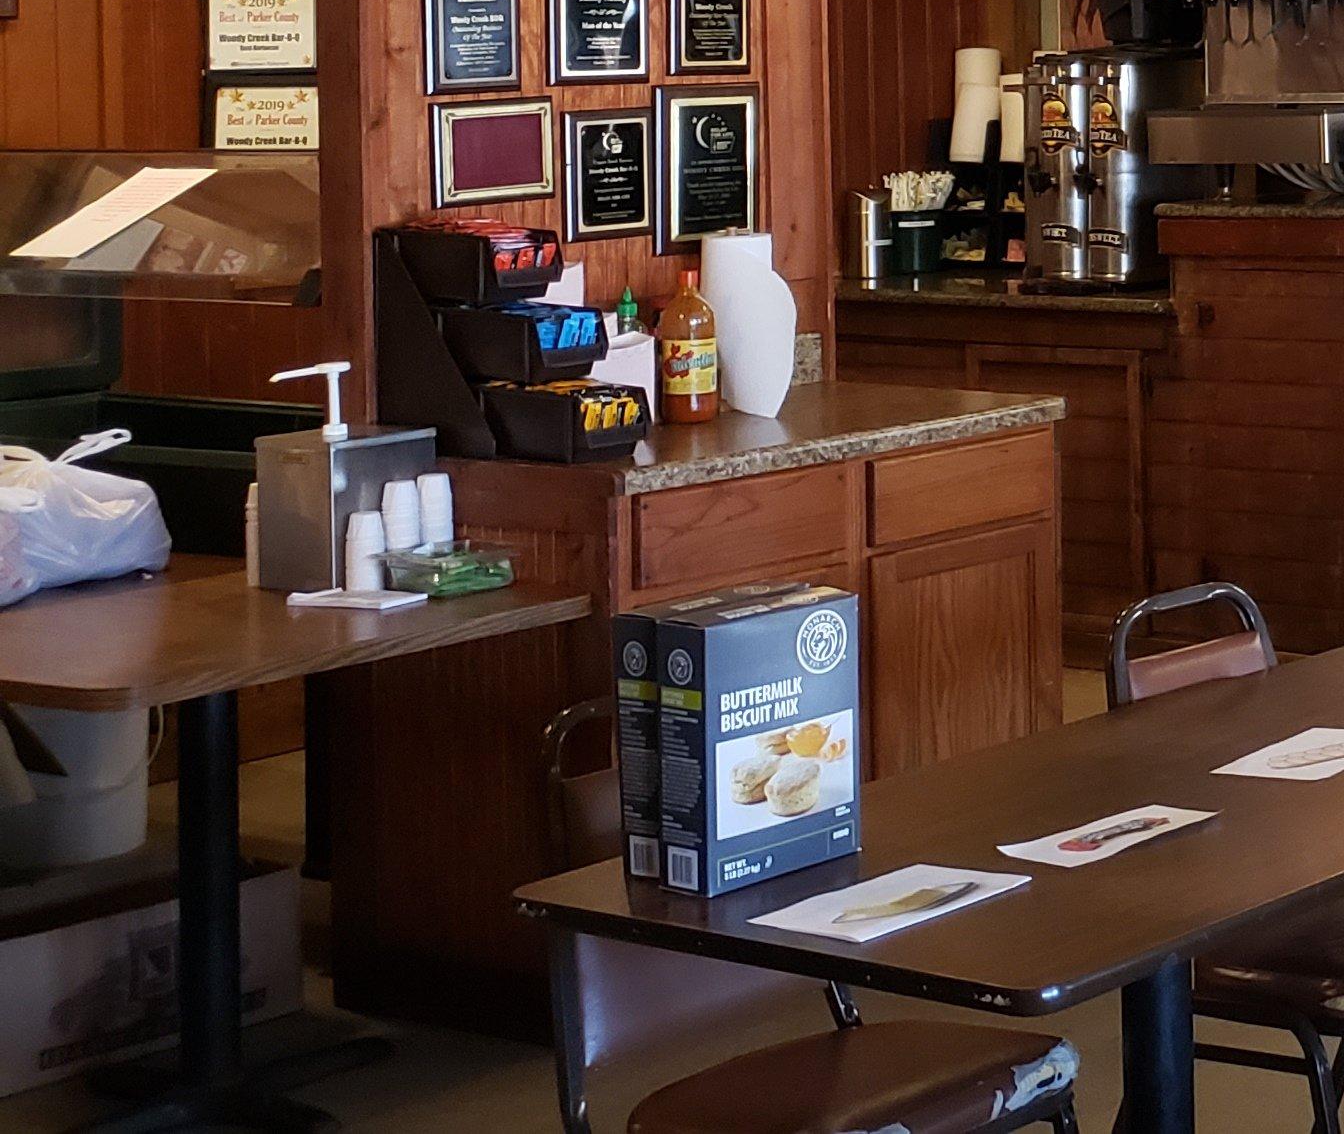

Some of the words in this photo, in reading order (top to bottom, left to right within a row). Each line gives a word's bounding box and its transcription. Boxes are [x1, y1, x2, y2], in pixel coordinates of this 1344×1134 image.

[219, 11, 236, 23] Best
[247, 11, 272, 23] Parker
[274, 11, 299, 23] County
[581, 21, 594, 29] Man
[594, 21, 602, 29] of
[602, 21, 612, 29] the
[219, 34, 246, 44] Woody
[247, 33, 270, 42] Creek
[257, 100, 285, 110] 2019
[227, 114, 244, 126] Best
[255, 114, 281, 126] Parker
[283, 114, 308, 126] County
[1052, 129, 1070, 140] TEA
[1099, 130, 1118, 142] TEA
[226, 137, 253, 146] Woody
[254, 136, 277, 145] Creek
[802, 614, 841, 638] MONARCH
[720, 676, 803, 712] BUTTERMILK
[720, 704, 772, 734] BISCUIT
[774, 697, 799, 721] MIX
